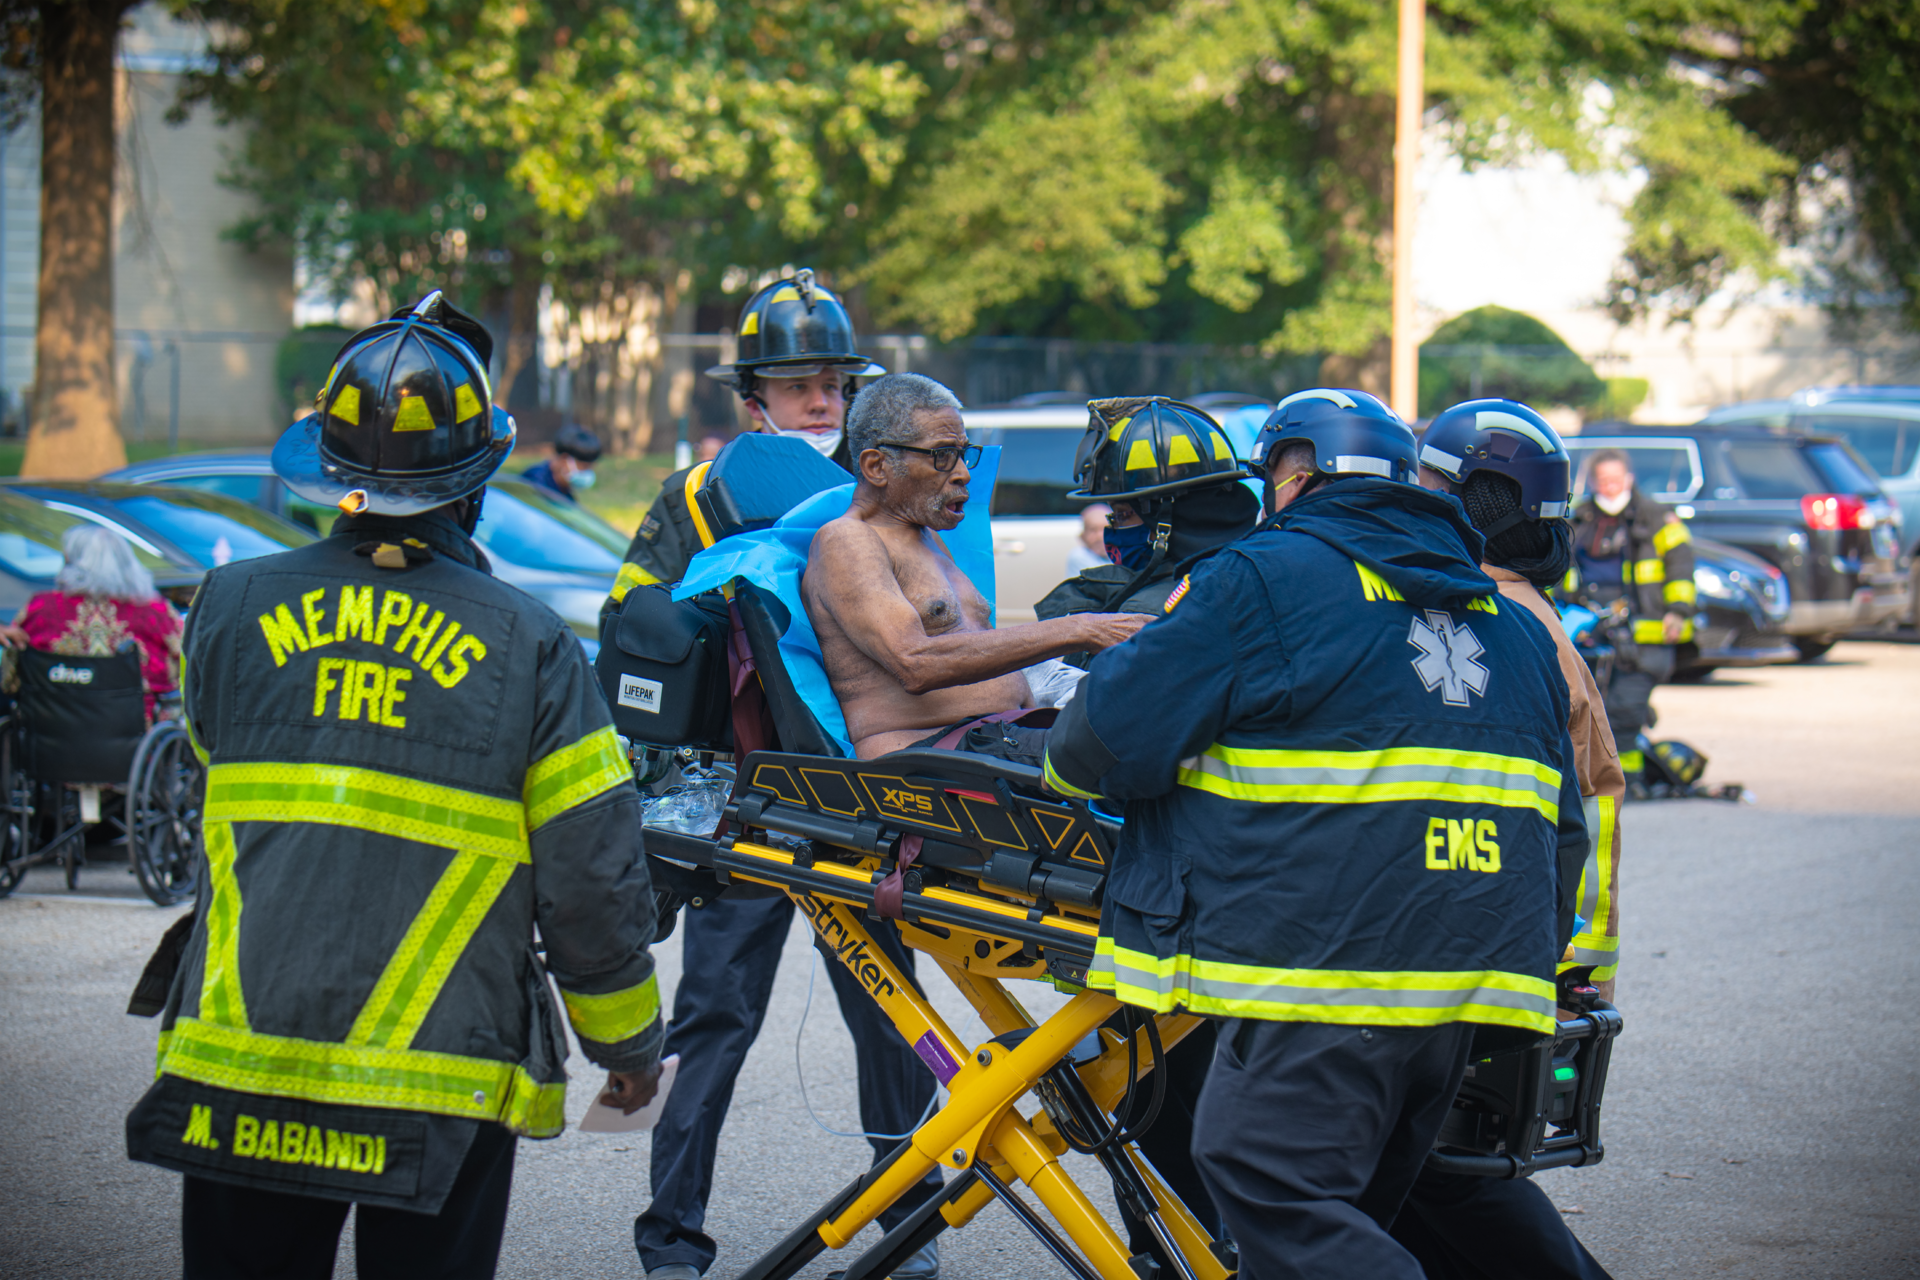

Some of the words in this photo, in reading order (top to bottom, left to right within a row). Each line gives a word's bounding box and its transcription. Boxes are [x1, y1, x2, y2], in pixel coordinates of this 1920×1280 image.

[258, 585, 487, 689] MEMPHIS
[313, 657, 412, 728] FIRE
[624, 684, 654, 700] LIFEPAK
[881, 786, 933, 812] XPS
[1425, 816, 1502, 873] EMS
[796, 896, 895, 997] stryker
[181, 1103, 219, 1150] M.
[233, 1114, 386, 1175] BABANDI
